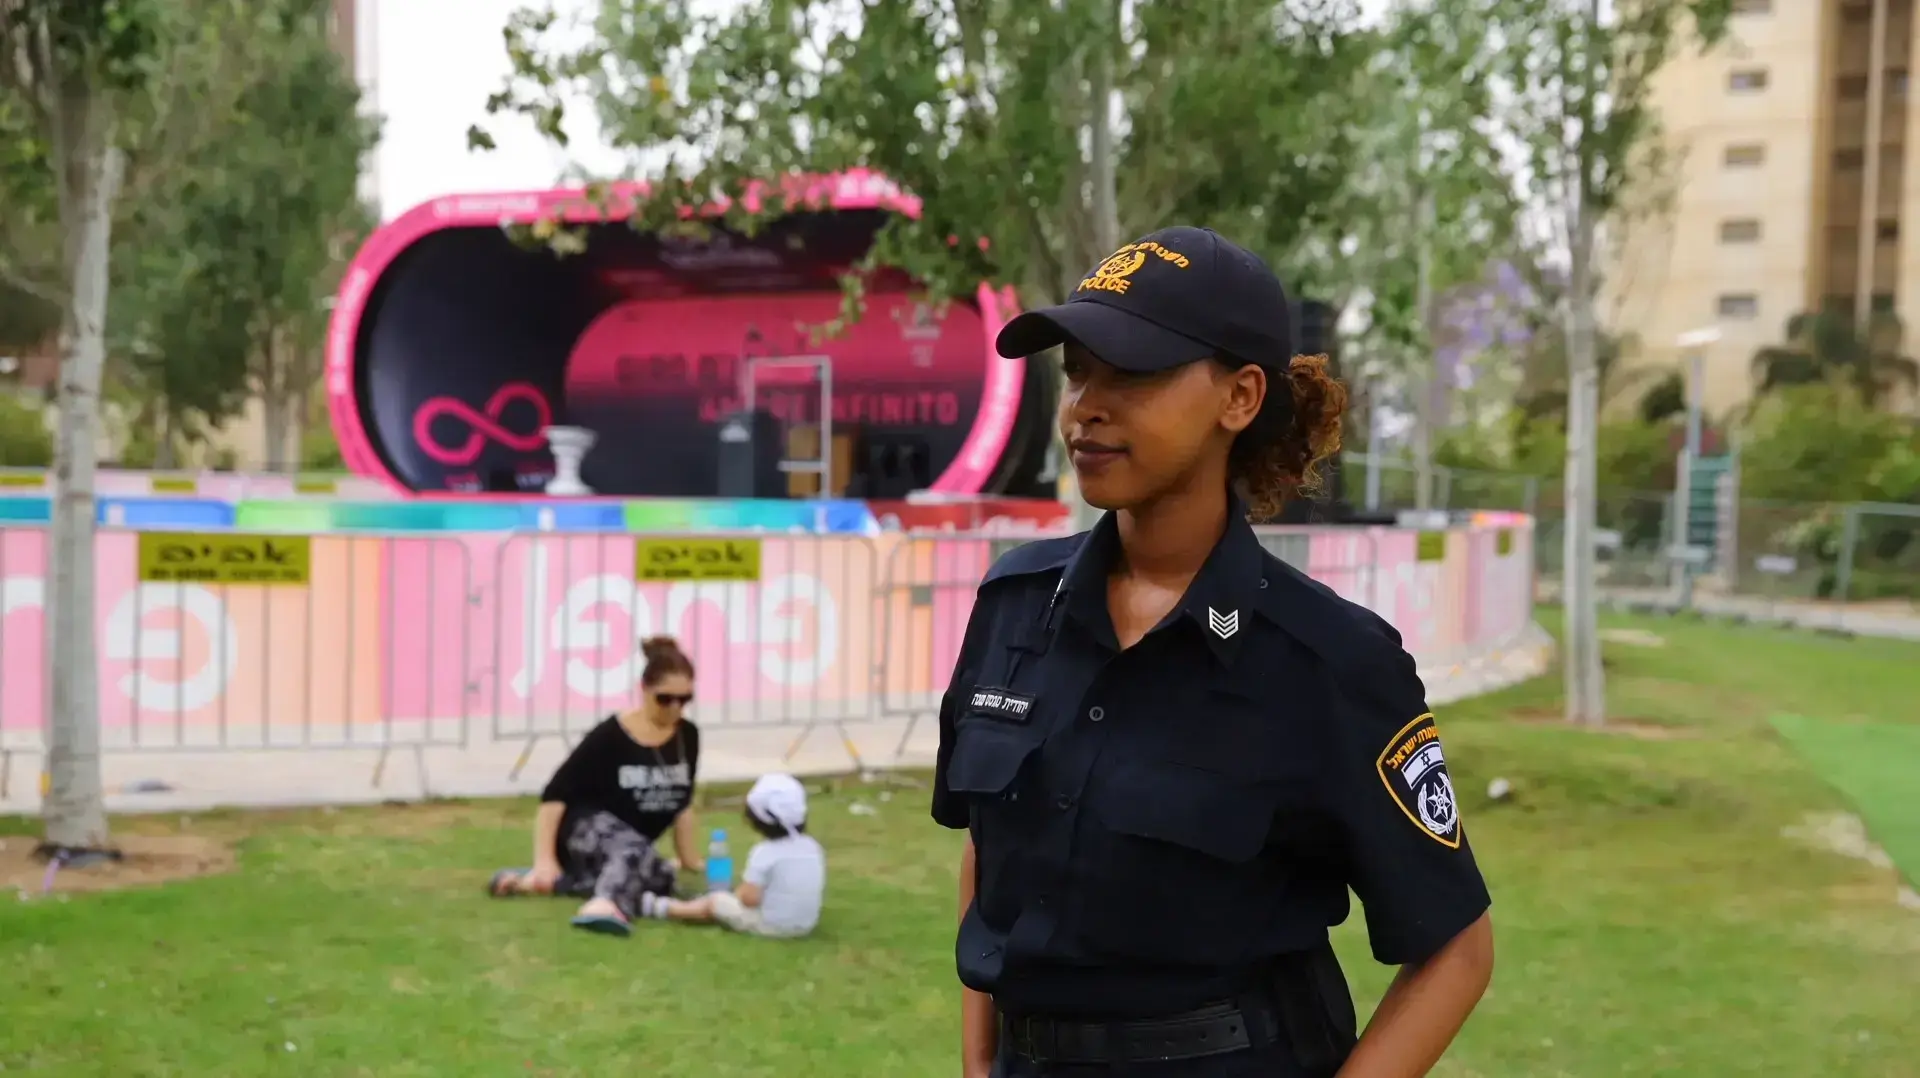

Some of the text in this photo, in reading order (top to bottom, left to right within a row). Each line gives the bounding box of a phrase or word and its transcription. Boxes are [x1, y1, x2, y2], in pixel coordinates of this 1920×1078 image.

[1077, 276, 1131, 295] POLICE
[1001, 697, 1029, 714] יהודית
[1386, 736, 1417, 769] ישראל
